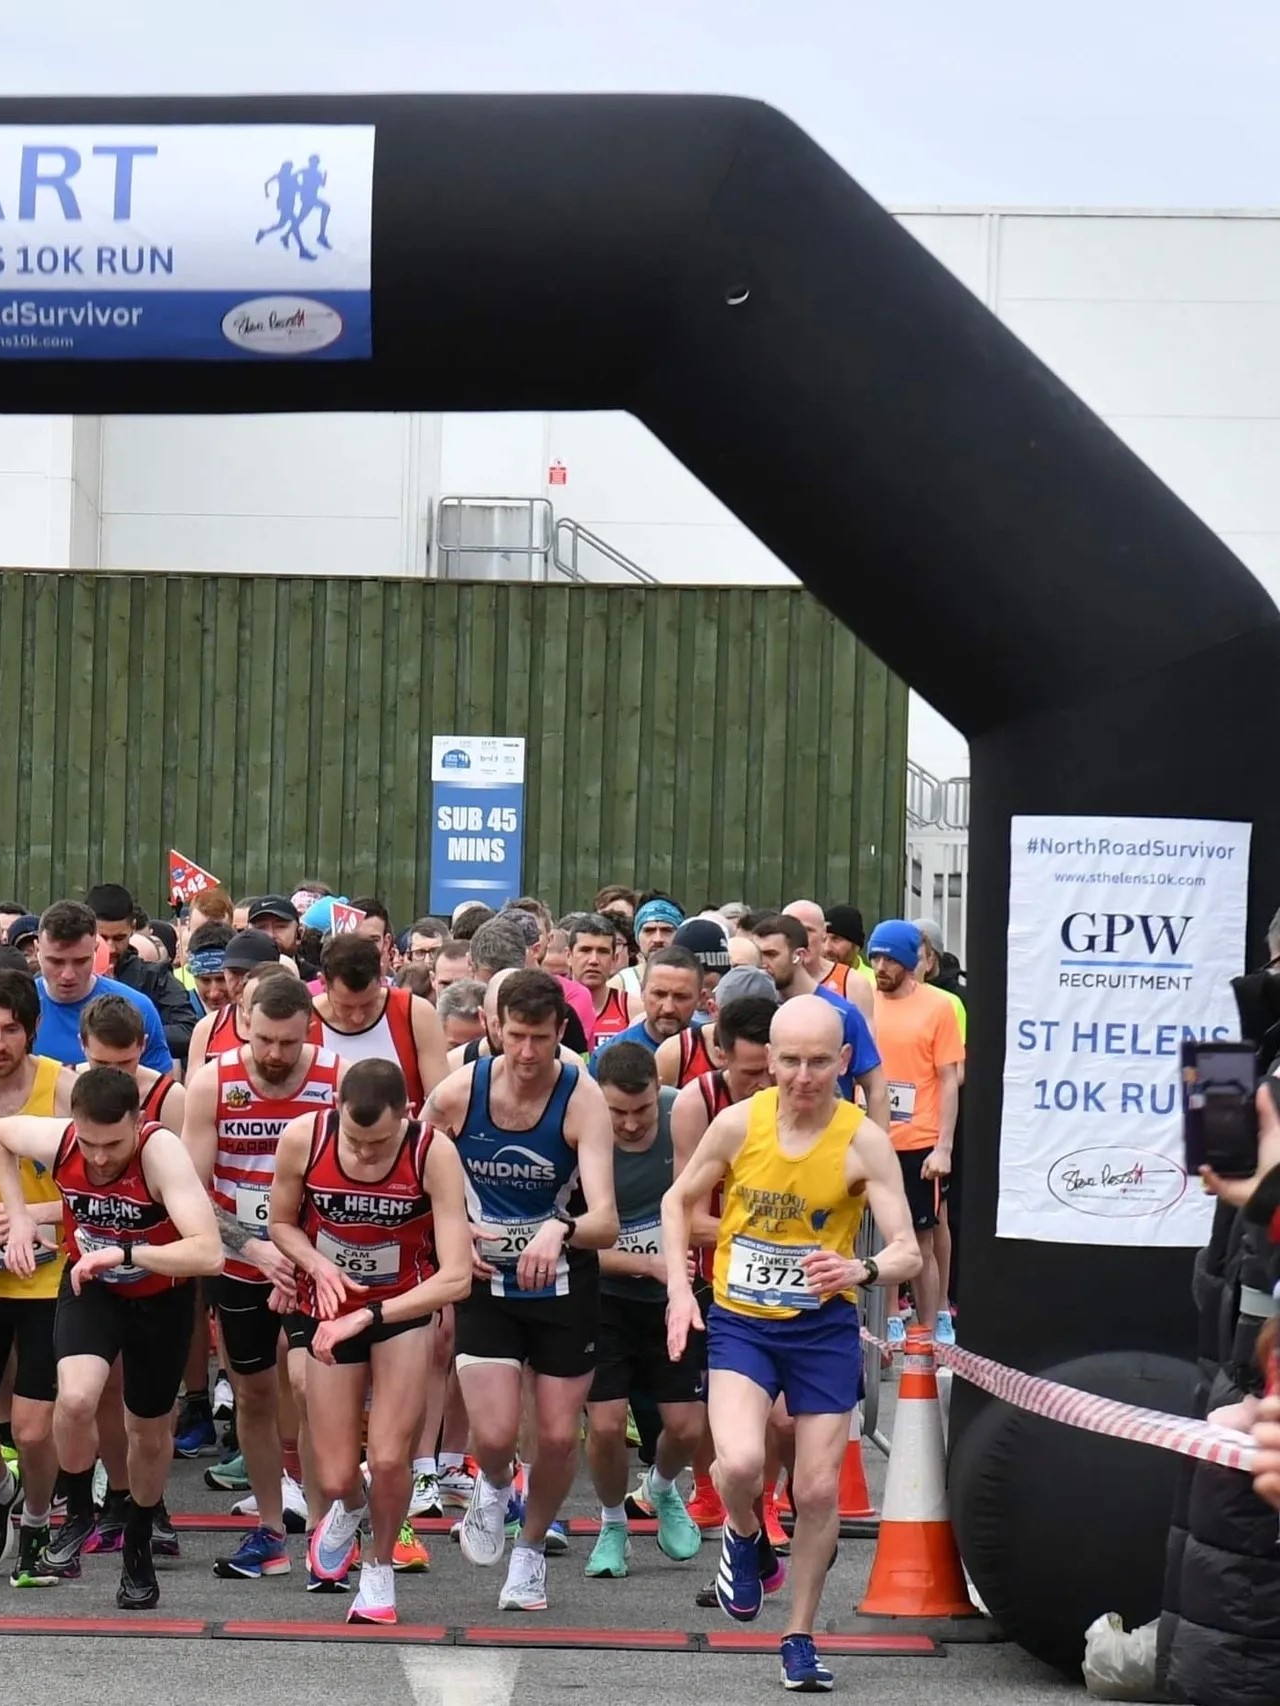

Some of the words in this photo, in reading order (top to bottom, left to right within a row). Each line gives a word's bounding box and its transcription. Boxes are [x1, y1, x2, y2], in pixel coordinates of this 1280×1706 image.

[16, 245, 86, 276] 10K
[96, 246, 175, 276] RUN
[437, 805, 483, 831] SUB
[487, 807, 517, 832] 45
[448, 837, 505, 863] MINS
[1026, 838, 1236, 861] #NorthRoadSurvivor
[1054, 871, 1206, 888] www.sthelens10k.com
[1060, 911, 1194, 957] GPW
[1059, 972, 1193, 991] RECRUITMENT
[1018, 1019, 1060, 1052] ST
[1033, 1080, 1107, 1114] 10K
[1121, 1082, 1183, 1116] RU
[467, 1157, 556, 1180] WIDNES
[313, 1193, 337, 1211] ST.
[344, 1195, 413, 1216] HELENS
[507, 1227, 533, 1236] WILL
[334, 1252, 377, 1272] 563
[343, 1249, 369, 1259] CAM
[751, 1252, 798, 1266] SANKEY
[745, 1263, 805, 1287] 1372
